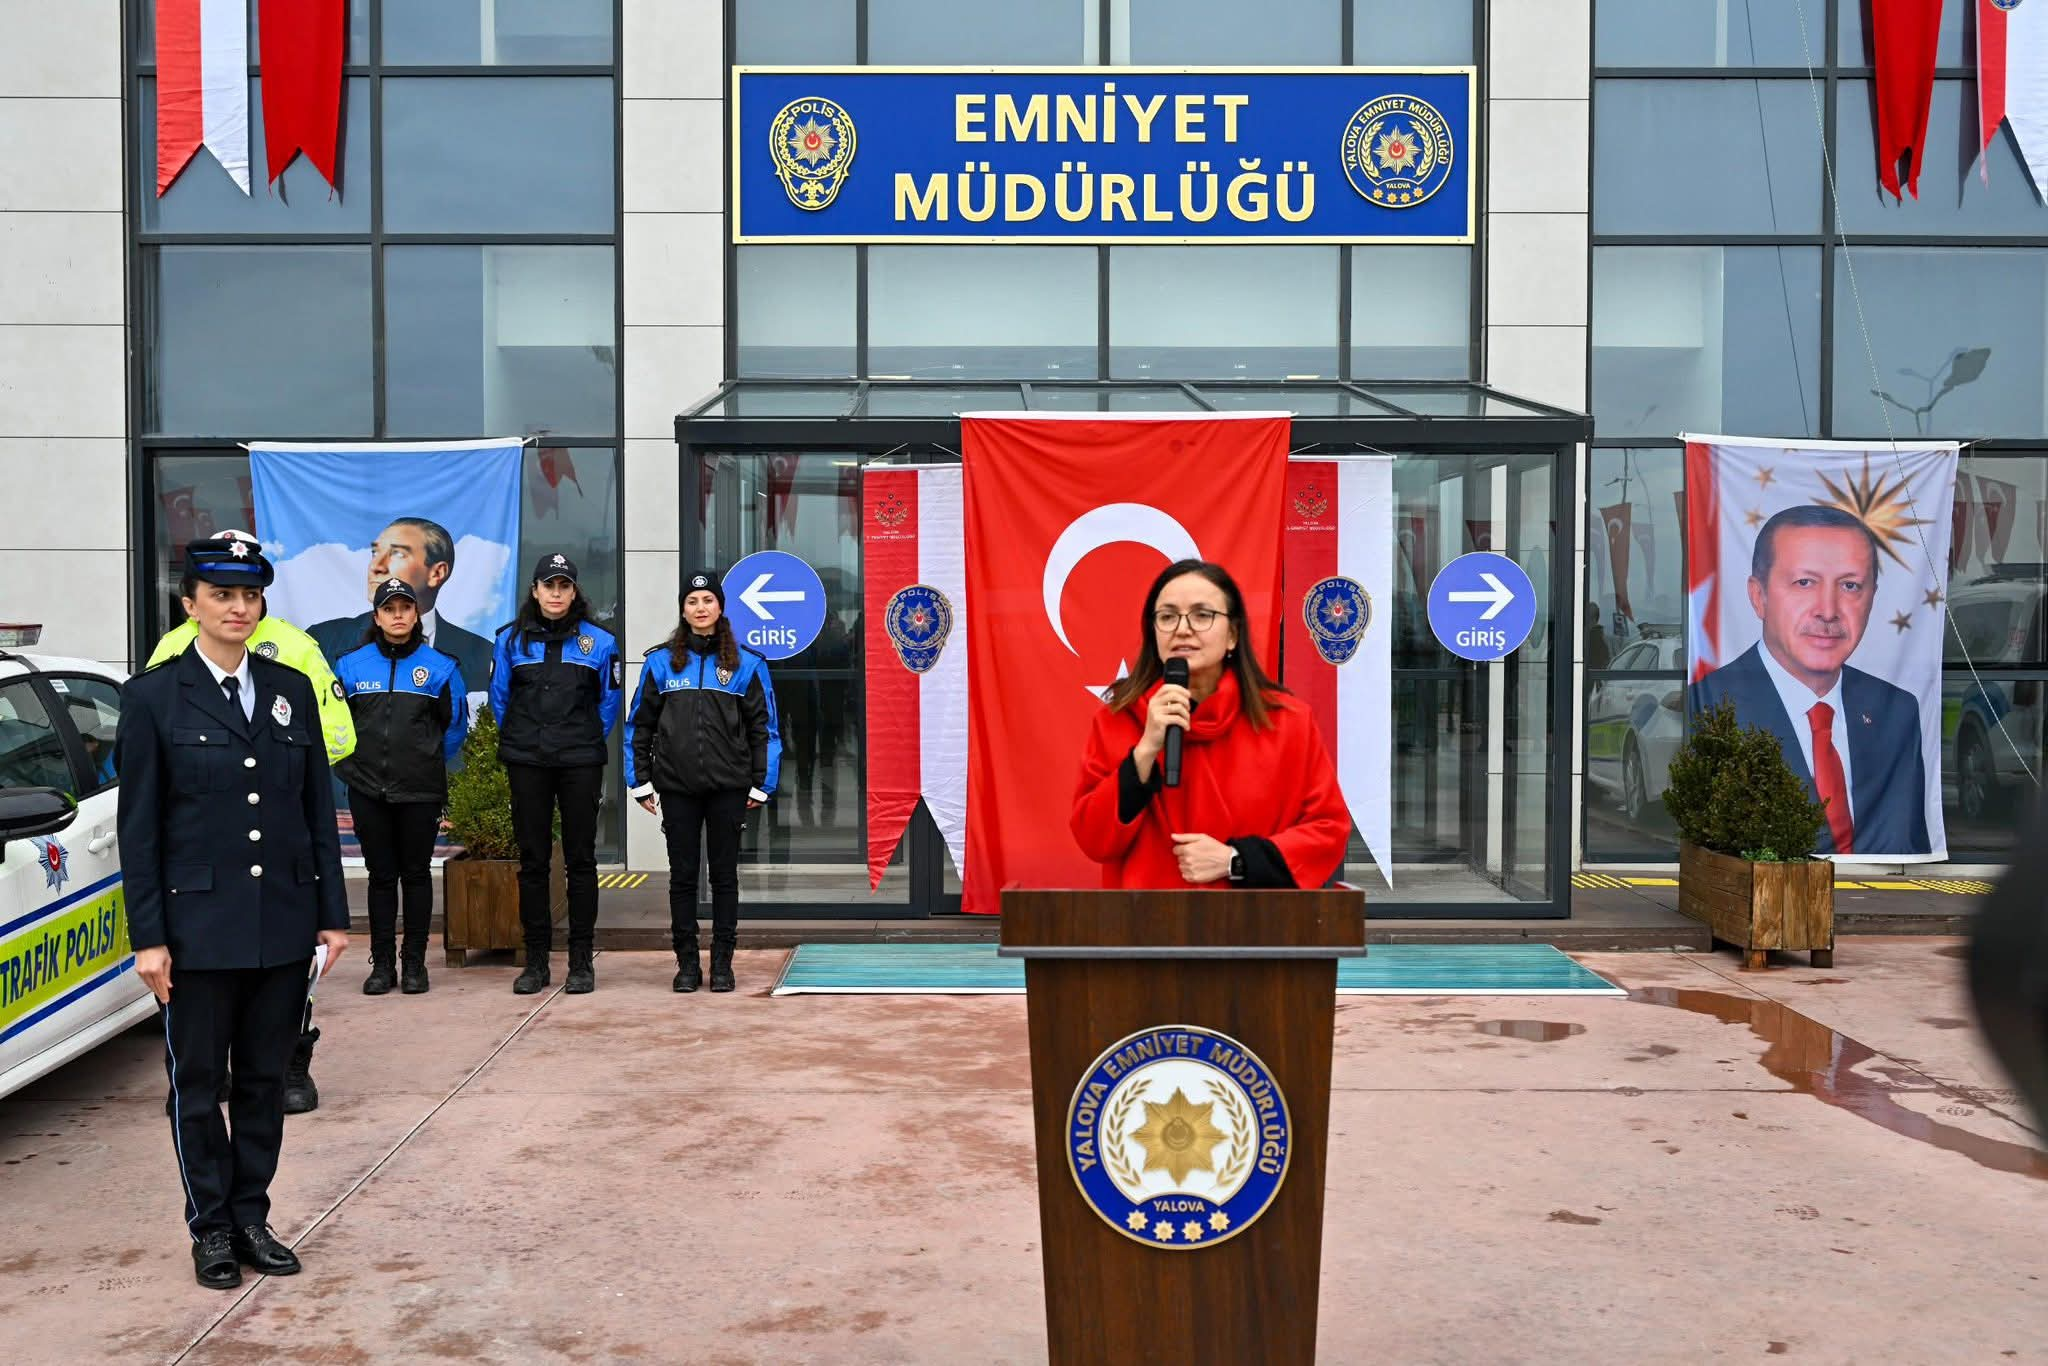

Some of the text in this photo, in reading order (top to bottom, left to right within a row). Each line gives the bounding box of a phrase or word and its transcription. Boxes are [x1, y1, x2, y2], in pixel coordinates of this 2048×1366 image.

[790, 102, 835, 118] POLİS
[955, 83, 1249, 143] EMNİYET
[1346, 99, 1450, 170] YALOVA EMNİYET MÜDÜRLÜĞÜ
[894, 157, 1316, 222] MÜDÜRLÜĞÜ
[1385, 182, 1412, 190] YALOVA
[746, 625, 798, 650] GİRİŞ
[1455, 626, 1506, 651] GİRİŞ
[0, 900, 117, 1009] TRAFİK POLİSİ
[1075, 1031, 1286, 1175] YALOVA EMNİYET MÜDÜRLÜĞÜ
[1153, 1200, 1206, 1213] YALOVA
